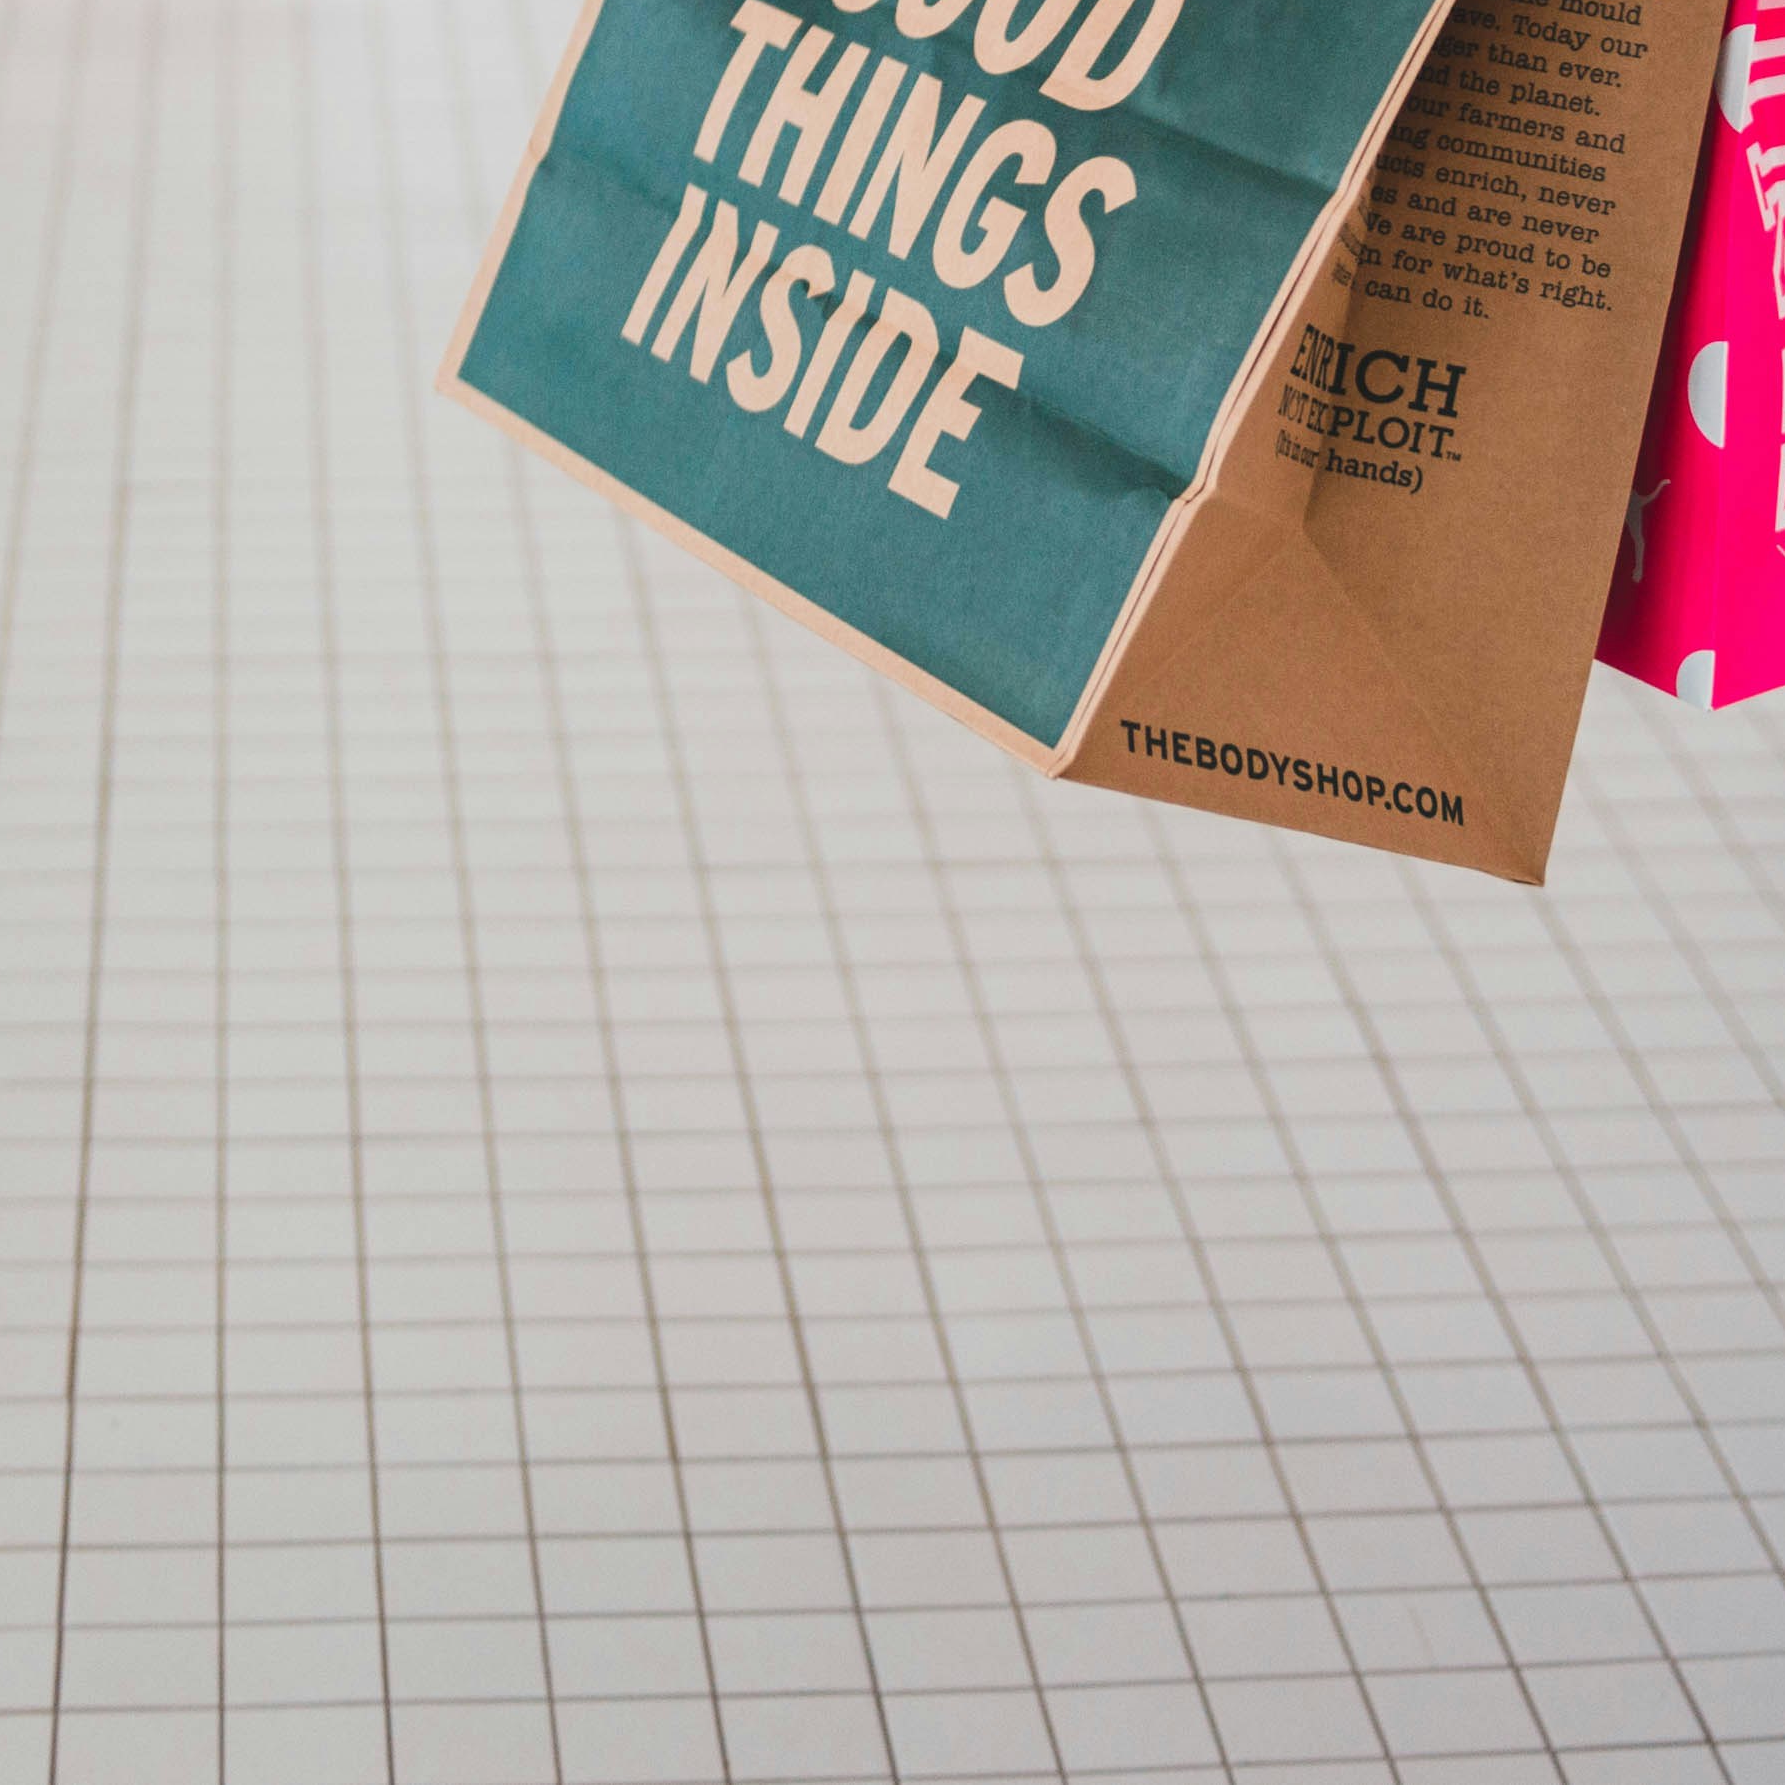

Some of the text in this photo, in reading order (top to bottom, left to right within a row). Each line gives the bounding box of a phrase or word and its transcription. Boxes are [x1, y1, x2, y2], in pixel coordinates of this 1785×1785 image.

[1512, 14, 1592, 52] Today
[1600, 35, 1648, 59] our
[1488, 43, 1548, 73] than
[1559, 61, 1622, 88] ever.
[1459, 69, 1500, 96] the
[1509, 82, 1601, 116] planet.
[1458, 102, 1565, 142] farmers
[1575, 129, 1626, 155] and
[1375, 153, 1617, 216] ucts enrich, never
[1437, 133, 1607, 183] communities
[1407, 192, 1457, 216] and
[1467, 205, 1513, 227] are
[1522, 216, 1601, 245] never
[1402, 224, 1447, 246] are
[1455, 232, 1535, 264] proud
[1545, 248, 1571, 271] to
[1581, 254, 1612, 279] be
[1365, 278, 1490, 319] can do it.
[1392, 248, 1433, 275] for
[1443, 260, 1530, 294] what's
[1539, 280, 1613, 312] right.
[620, 182, 1025, 520] INSIDE
[1290, 323, 1467, 419] ENRICH
[1278, 383, 1309, 424] NOT
[1325, 448, 1424, 495] hands)
[1120, 719, 1465, 827] THEBODYSHOP.COM
